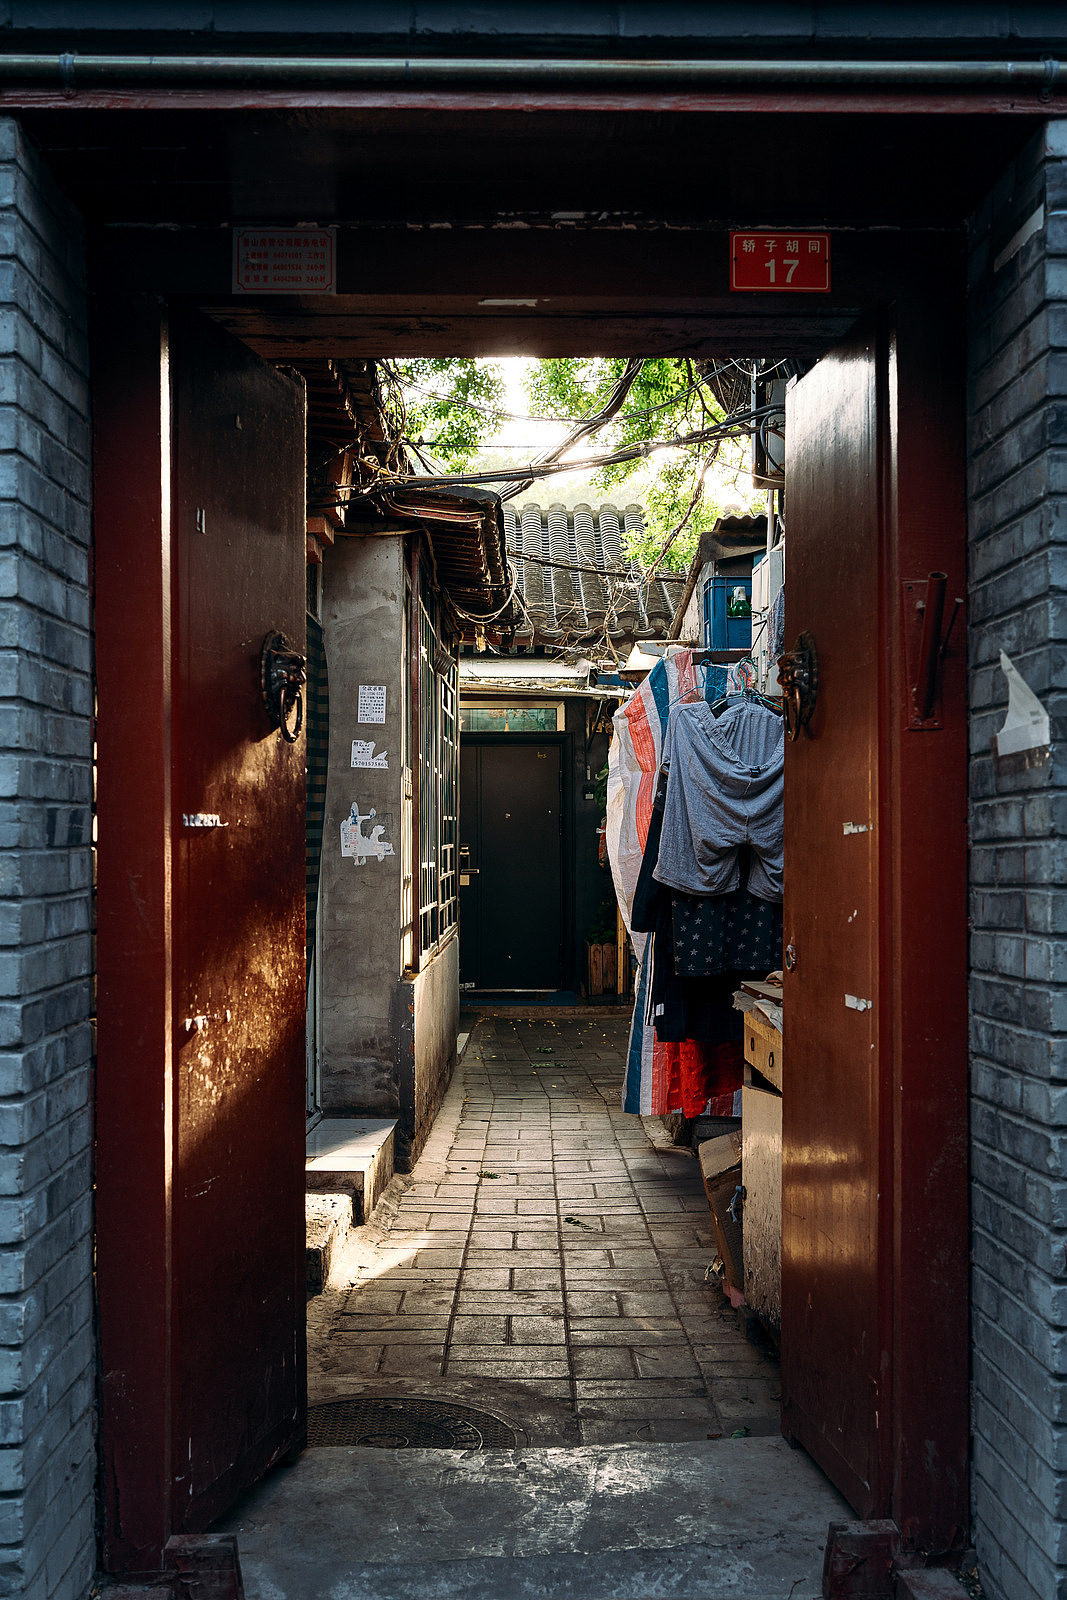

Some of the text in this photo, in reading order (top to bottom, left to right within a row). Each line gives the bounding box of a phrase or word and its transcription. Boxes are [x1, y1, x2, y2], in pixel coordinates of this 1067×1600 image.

[742, 239, 821, 254] 轿子胡同
[765, 258, 800, 283] 17
